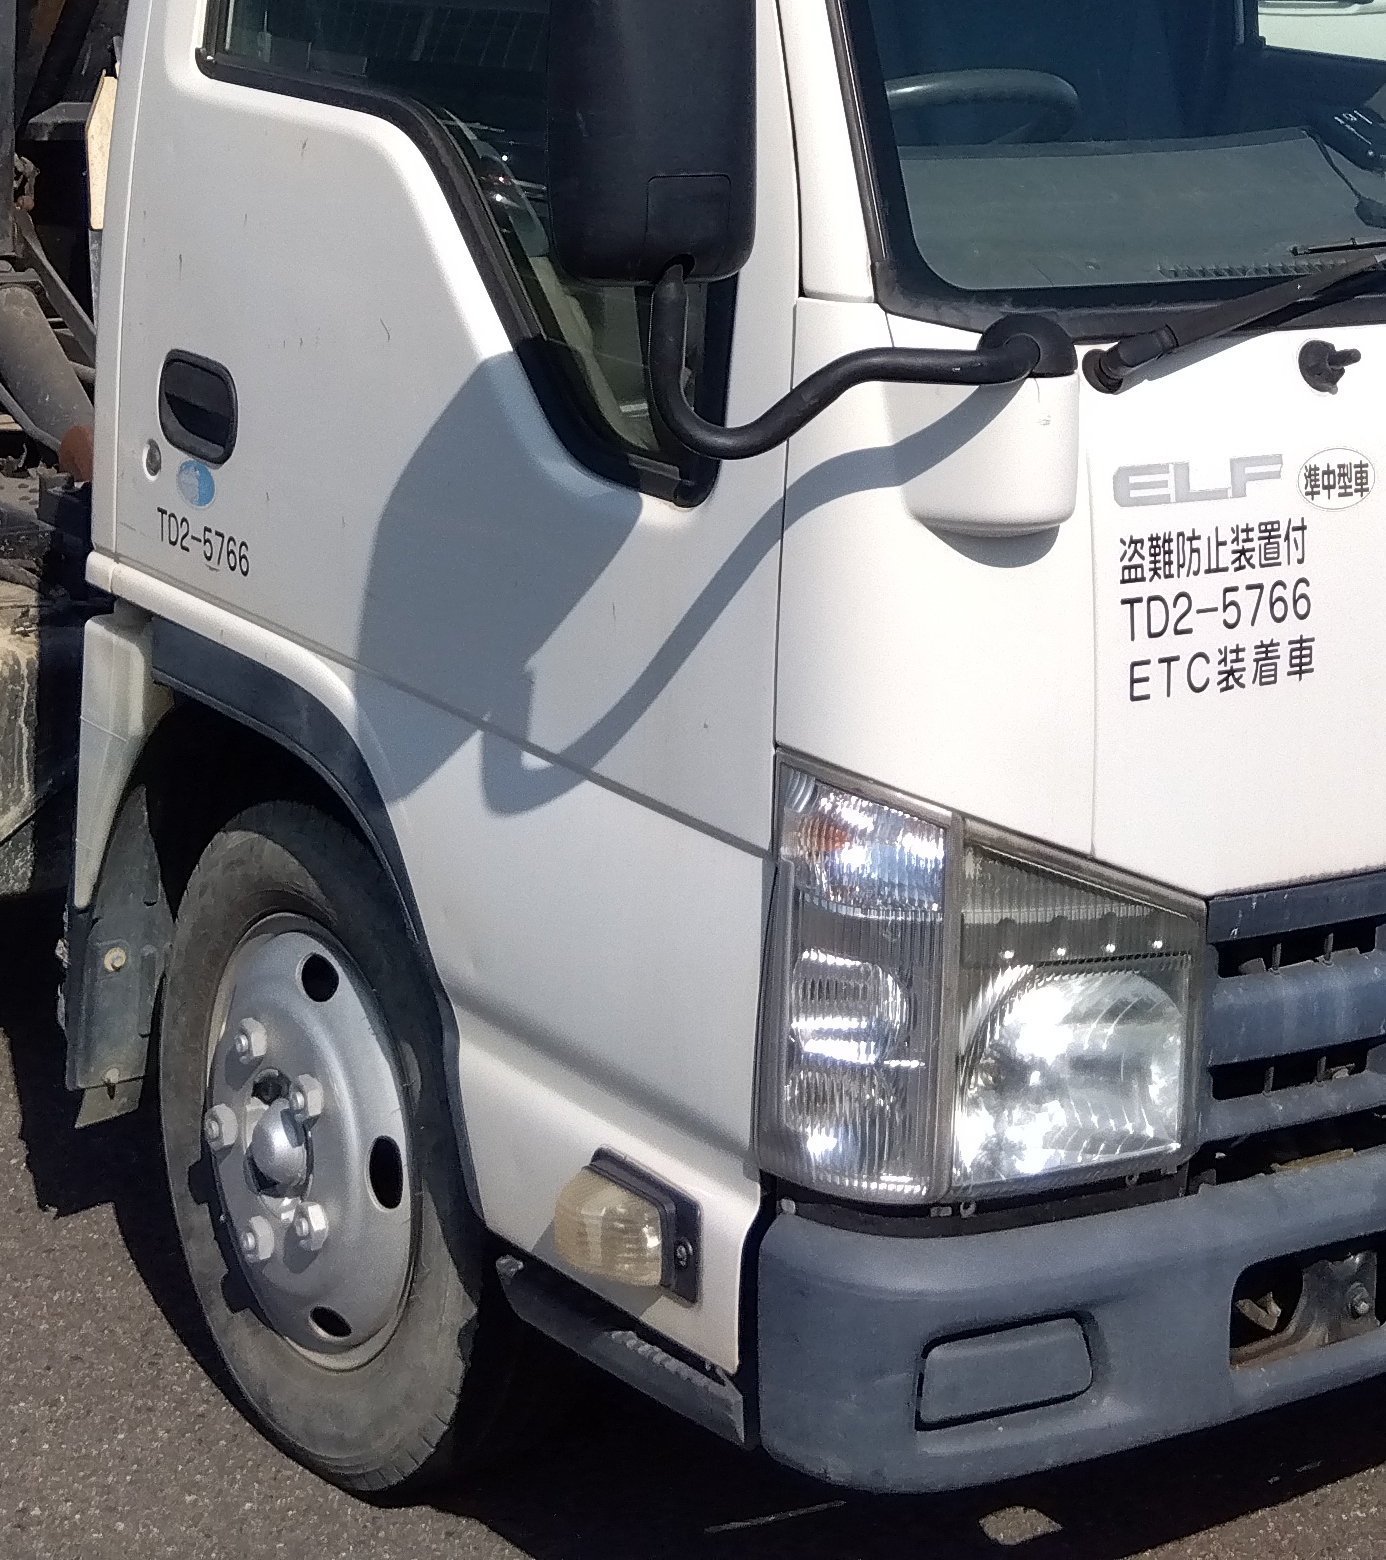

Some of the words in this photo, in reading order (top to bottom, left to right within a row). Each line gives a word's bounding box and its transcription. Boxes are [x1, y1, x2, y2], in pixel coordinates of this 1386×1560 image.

[1112, 453, 1284, 508] ELF
[1304, 459, 1370, 501] 準中型車
[156, 506, 250, 577] TD2-5766
[1119, 516, 1308, 585] 盗難防止装置付
[1119, 576, 1312, 642] TD2-5766
[1128, 633, 1316, 703] ETC装着車
